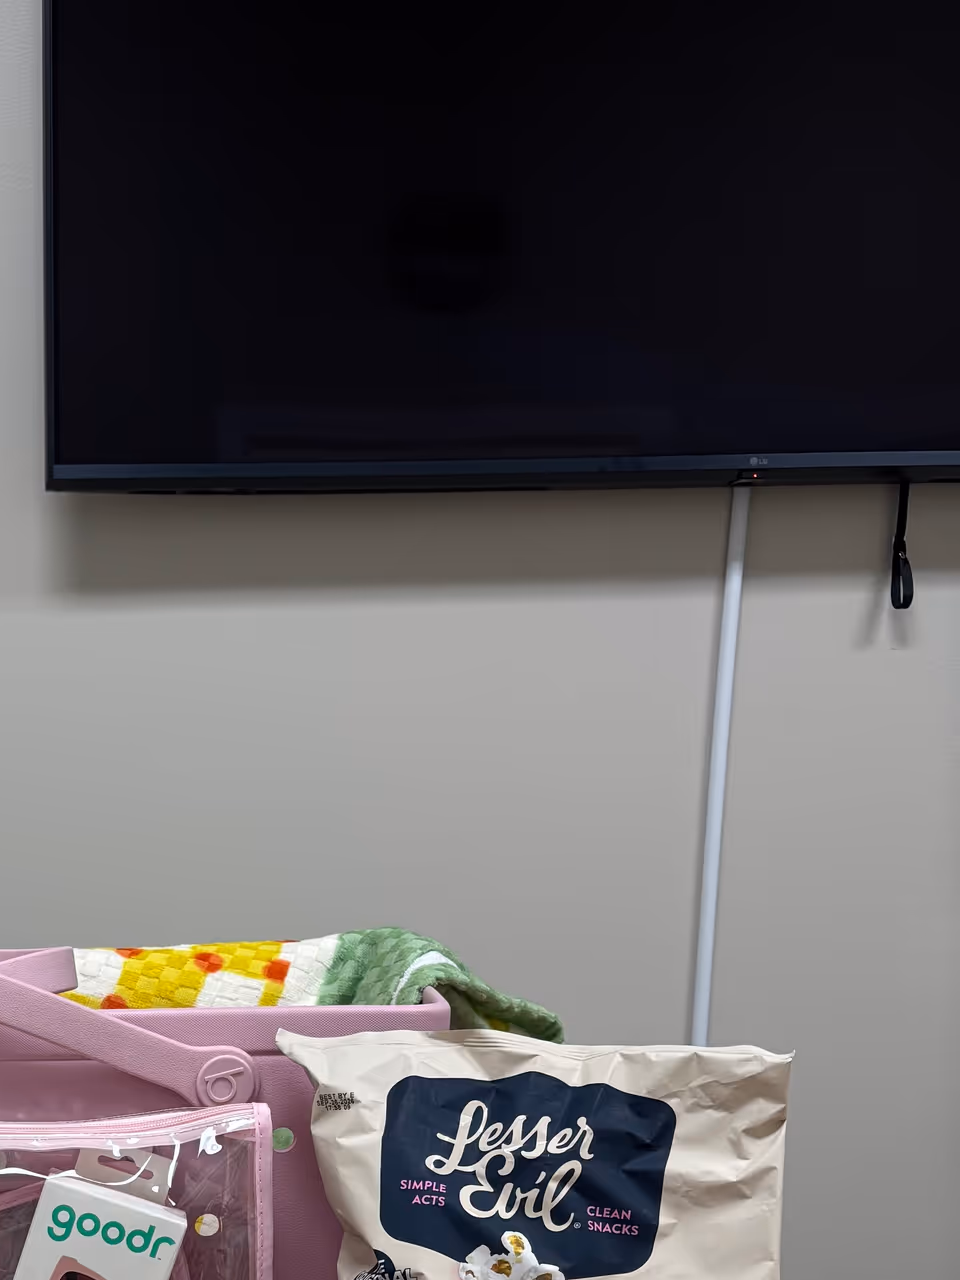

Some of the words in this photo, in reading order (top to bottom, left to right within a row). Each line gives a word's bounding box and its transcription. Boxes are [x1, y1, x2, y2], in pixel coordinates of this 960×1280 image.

[319, 1093, 336, 1101] BEST
[337, 1092, 347, 1100] BY
[424, 1099, 595, 1176] Lesser
[399, 1178, 448, 1195] SIMPLE
[458, 1149, 583, 1233] Evil
[411, 1193, 446, 1208] ACTS
[586, 1205, 632, 1221] CLEAN
[46, 1203, 177, 1260] goodr
[586, 1220, 640, 1236] SNACKS
